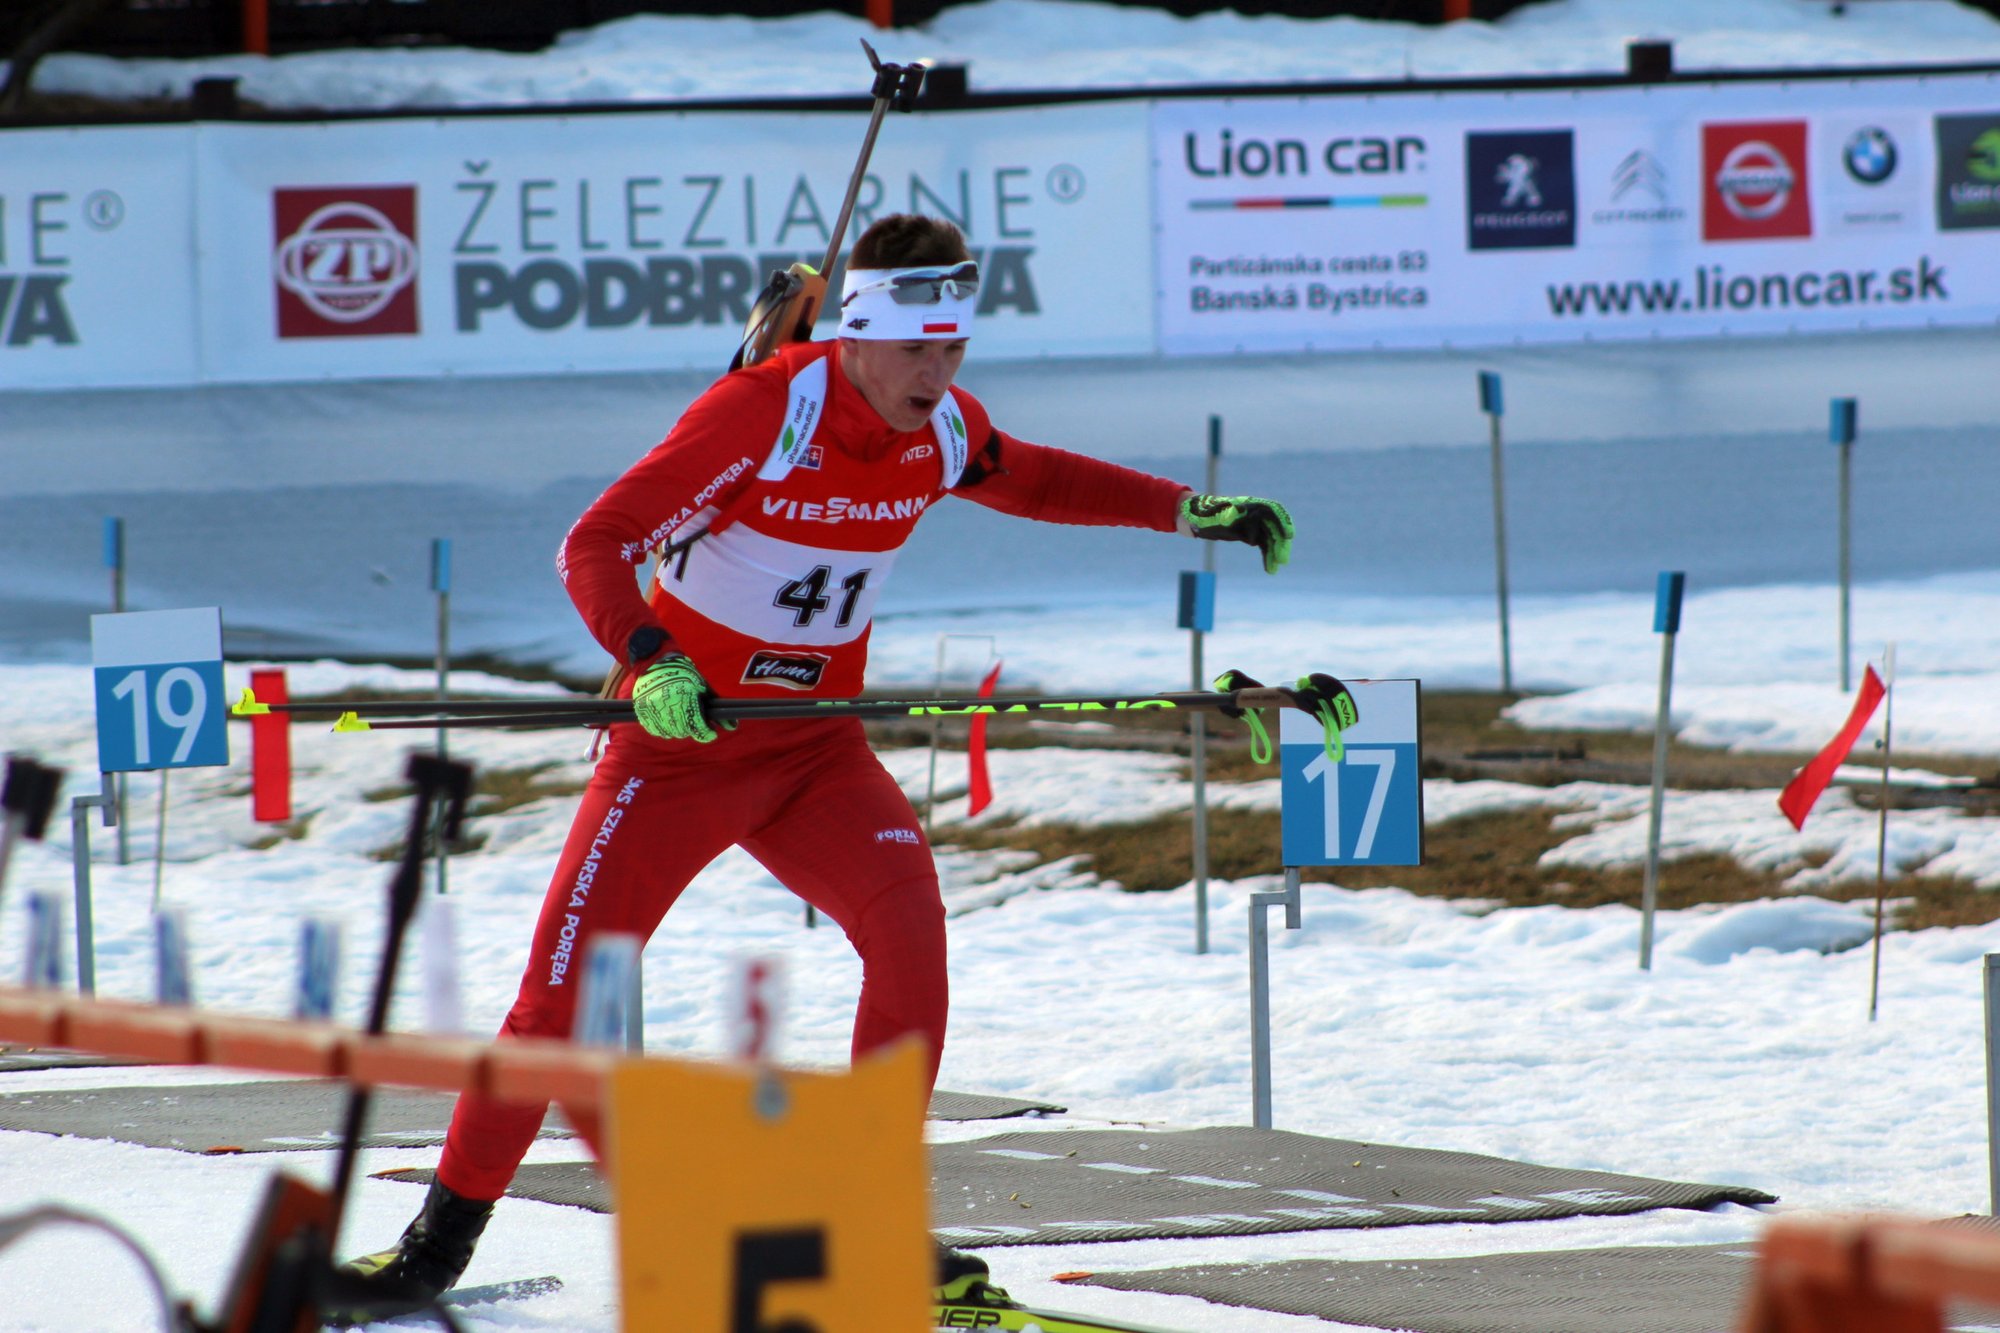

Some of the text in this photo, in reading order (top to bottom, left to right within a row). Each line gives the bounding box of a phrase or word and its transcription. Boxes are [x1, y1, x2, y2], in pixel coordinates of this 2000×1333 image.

[1185, 129, 1427, 178] Lion car
[0, 192, 71, 267] E
[453, 160, 1035, 254] ŽELEZIARNE
[1328, 252, 1393, 274] cesta
[1547, 255, 1949, 316] www.lioncar.sk
[847, 318, 870, 331] 4F
[1190, 281, 1428, 315] Banská Bystrica
[693, 456, 755, 507] PORĘBA
[772, 564, 873, 629] 41
[111, 666, 207, 764] 19
[1302, 748, 1396, 860] 17
[548, 776, 645, 986] SMS SZKLARSKA PORĘBA
